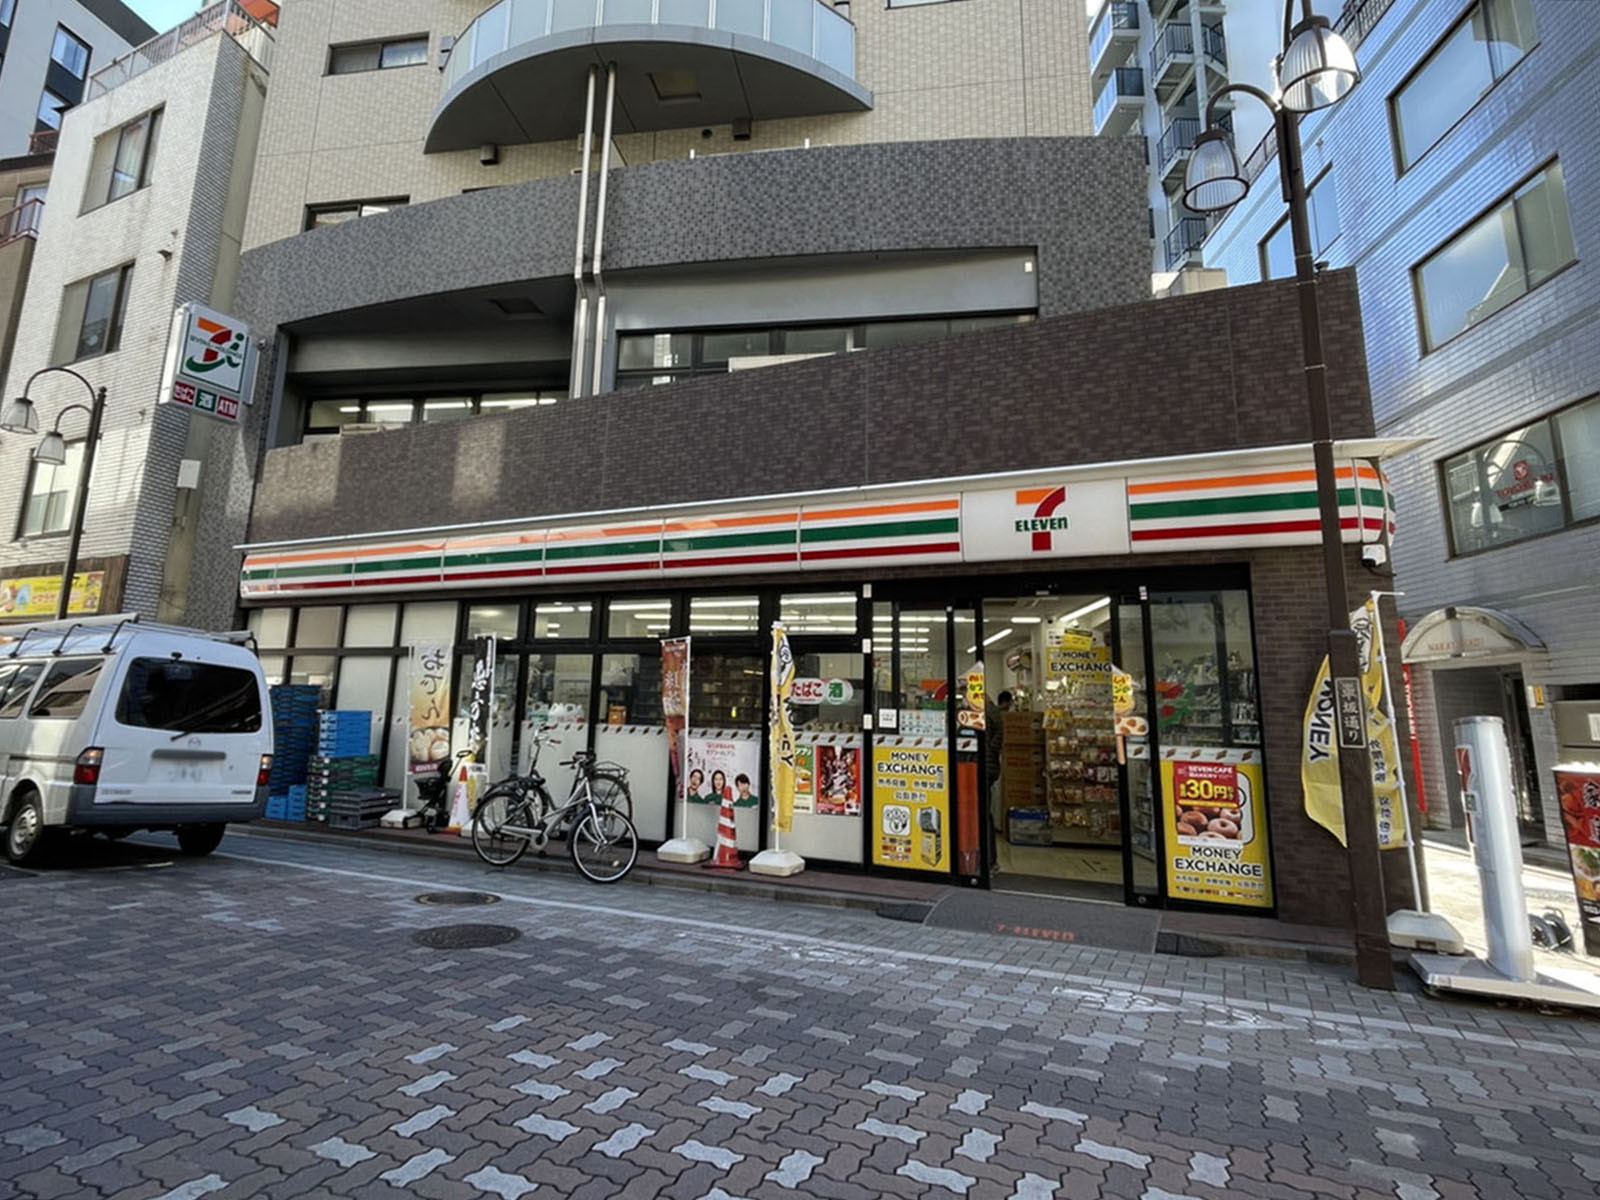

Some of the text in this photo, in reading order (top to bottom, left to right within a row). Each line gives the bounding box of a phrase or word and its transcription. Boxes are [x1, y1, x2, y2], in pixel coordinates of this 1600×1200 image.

[219, 399, 238, 415] ATM
[1062, 651, 1097, 659] MONEY
[1050, 662, 1112, 673] EXCHANG
[791, 682, 823, 698] たばこ
[828, 682, 843, 698] 酒
[891, 752, 929, 760] MONEY
[1192, 847, 1242, 859] MONEY
[1174, 858, 1262, 877] EXCHANGE
